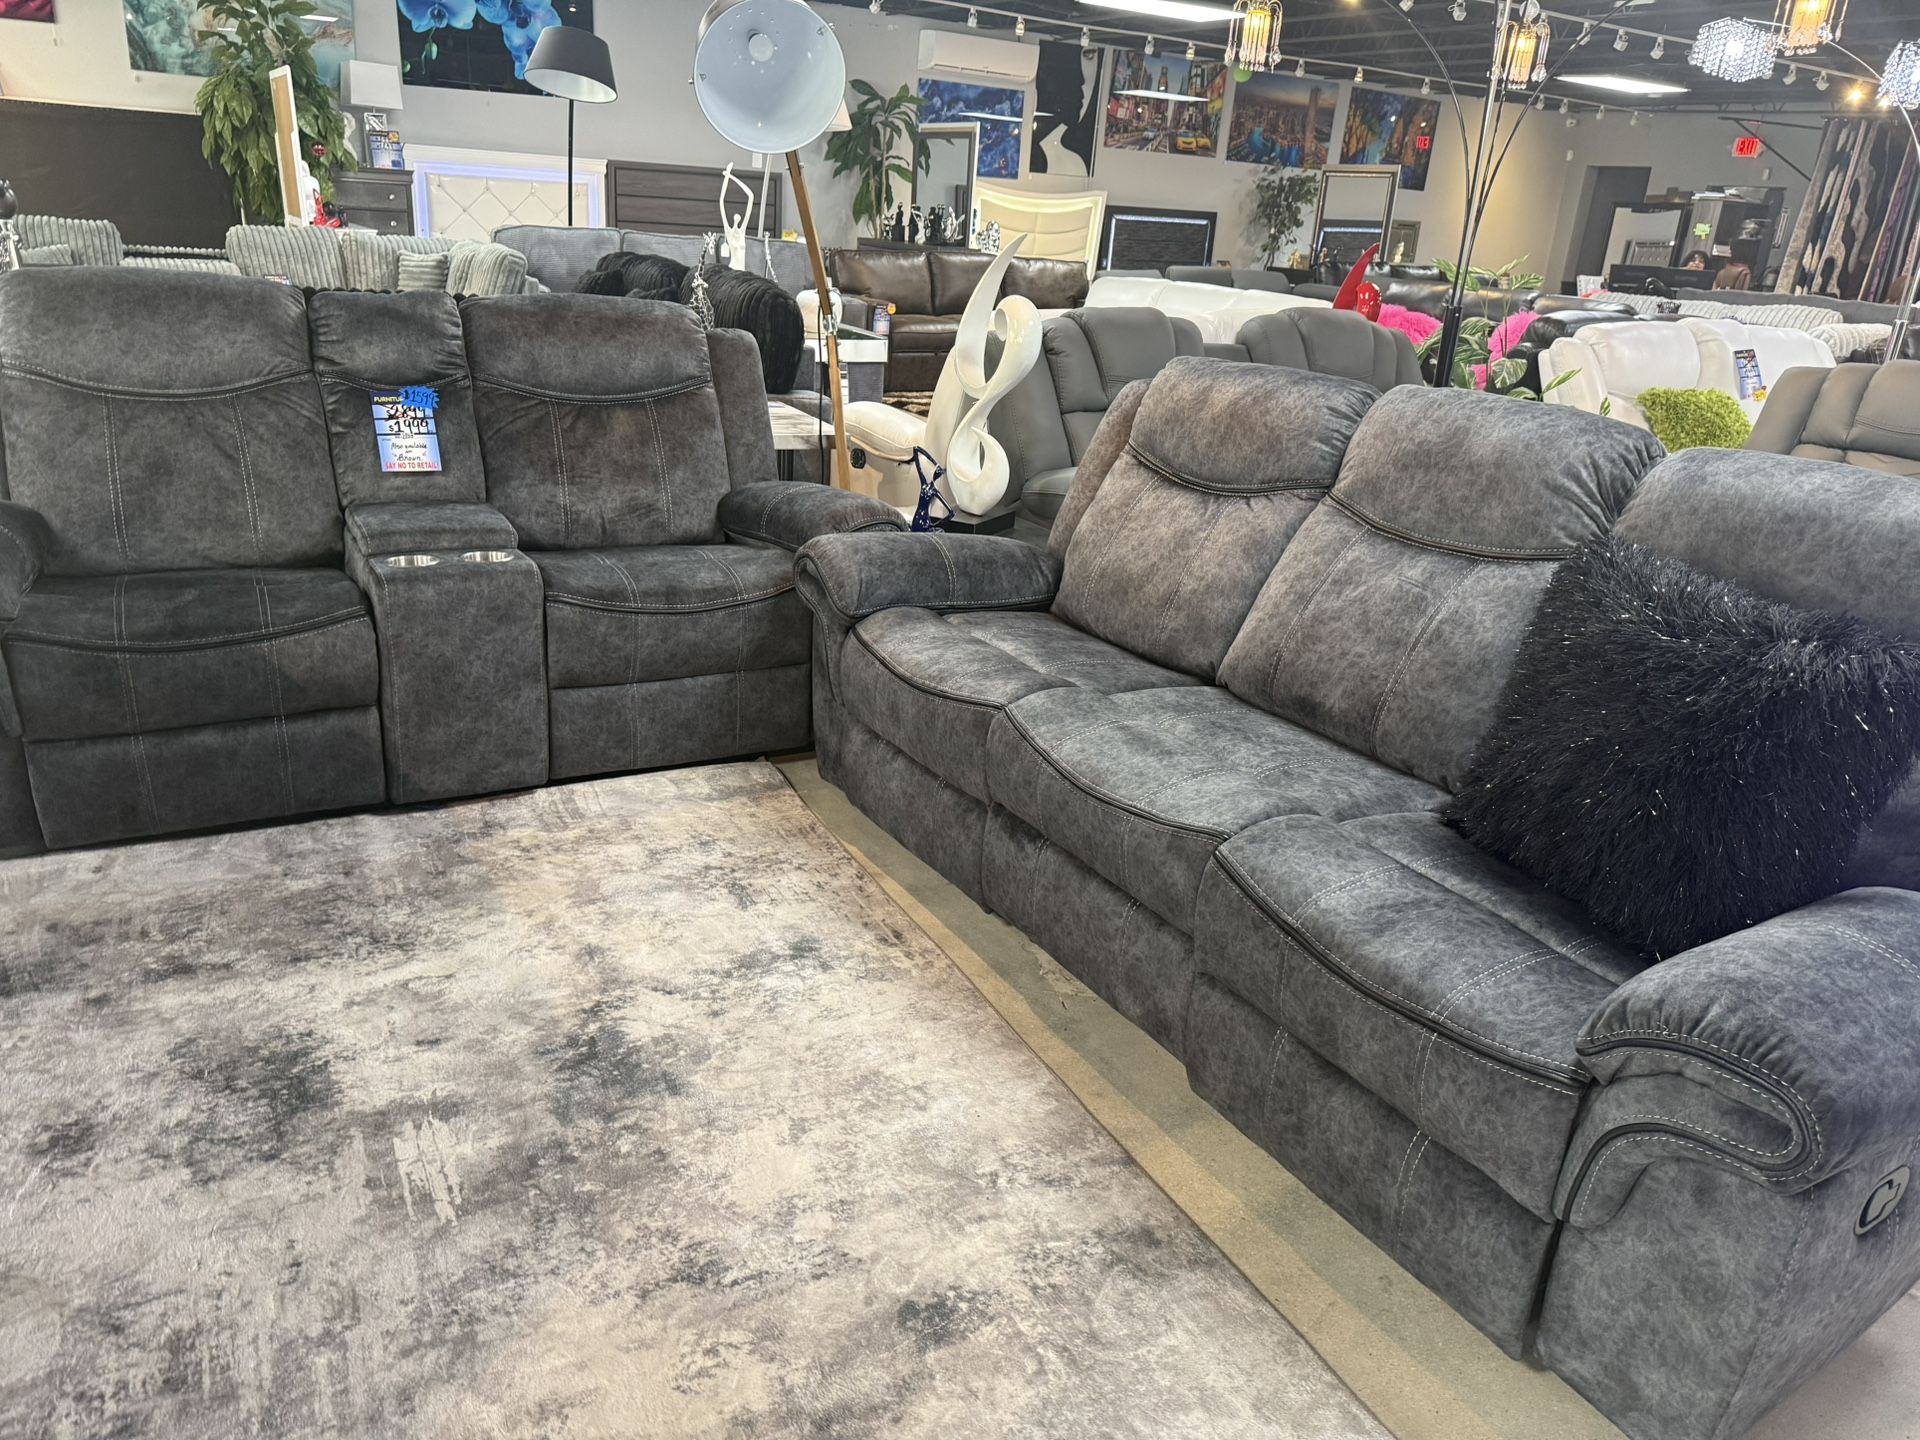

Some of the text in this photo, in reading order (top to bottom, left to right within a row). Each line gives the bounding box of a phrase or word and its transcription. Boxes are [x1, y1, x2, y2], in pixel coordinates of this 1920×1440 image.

[1736, 137, 1758, 156] EXIT
[389, 419, 428, 434] $1999
[385, 462, 396, 470] SAY
[397, 462, 407, 470] NO
[407, 462, 416, 470] TO
